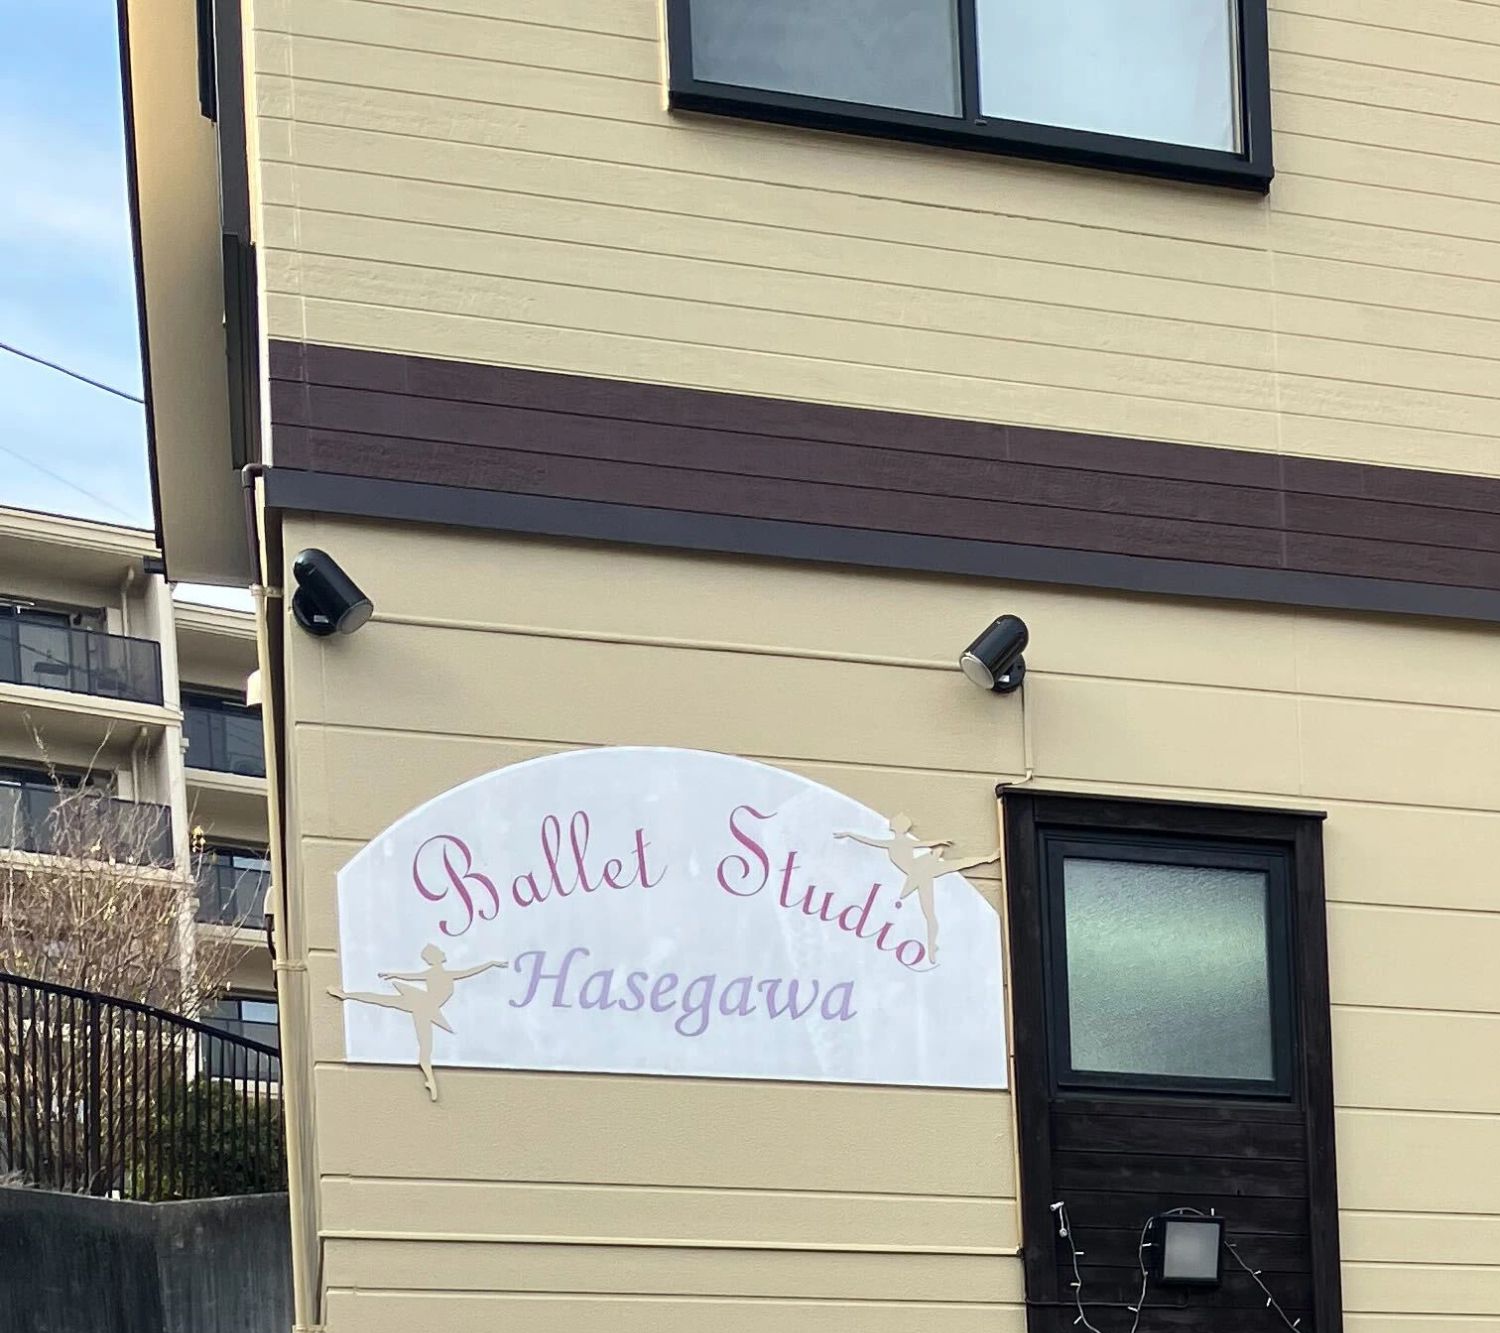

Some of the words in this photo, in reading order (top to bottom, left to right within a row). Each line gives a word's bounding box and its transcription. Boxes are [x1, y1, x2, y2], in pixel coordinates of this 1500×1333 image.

[411, 810, 667, 937] Ballet
[716, 805, 939, 972] Studio
[508, 947, 858, 1037] Hasegawa
